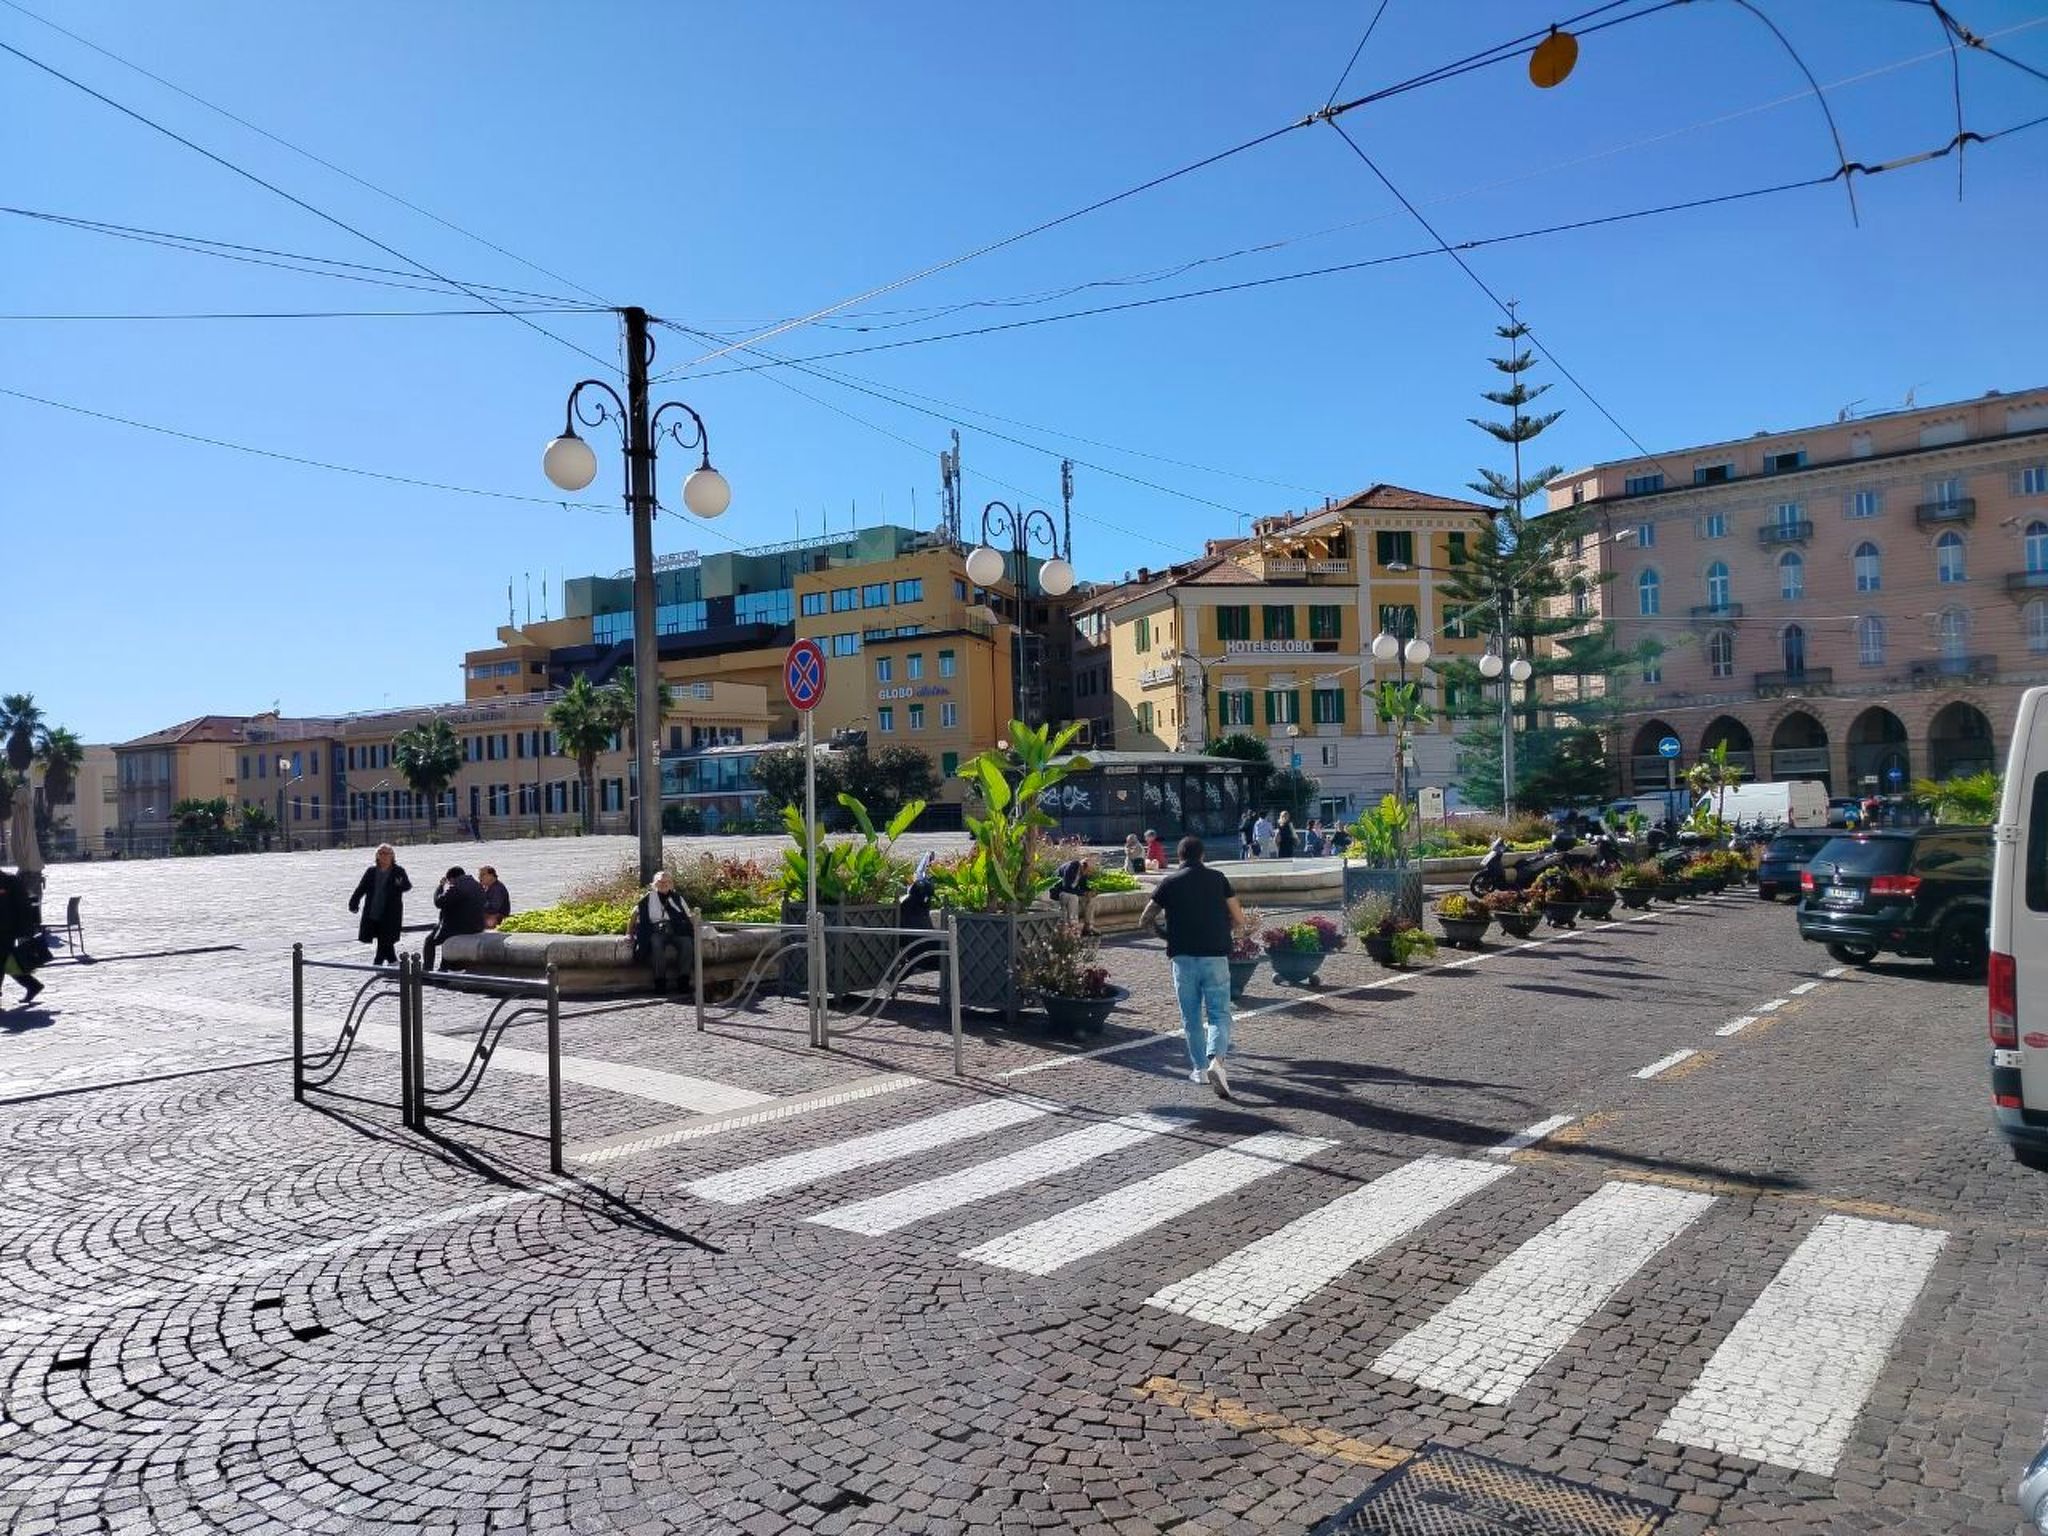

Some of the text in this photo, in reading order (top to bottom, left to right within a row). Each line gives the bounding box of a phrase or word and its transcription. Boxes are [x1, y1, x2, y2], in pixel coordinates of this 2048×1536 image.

[1227, 640, 1312, 652] HOTEL GLOBO
[879, 687, 912, 700] GLOBO
